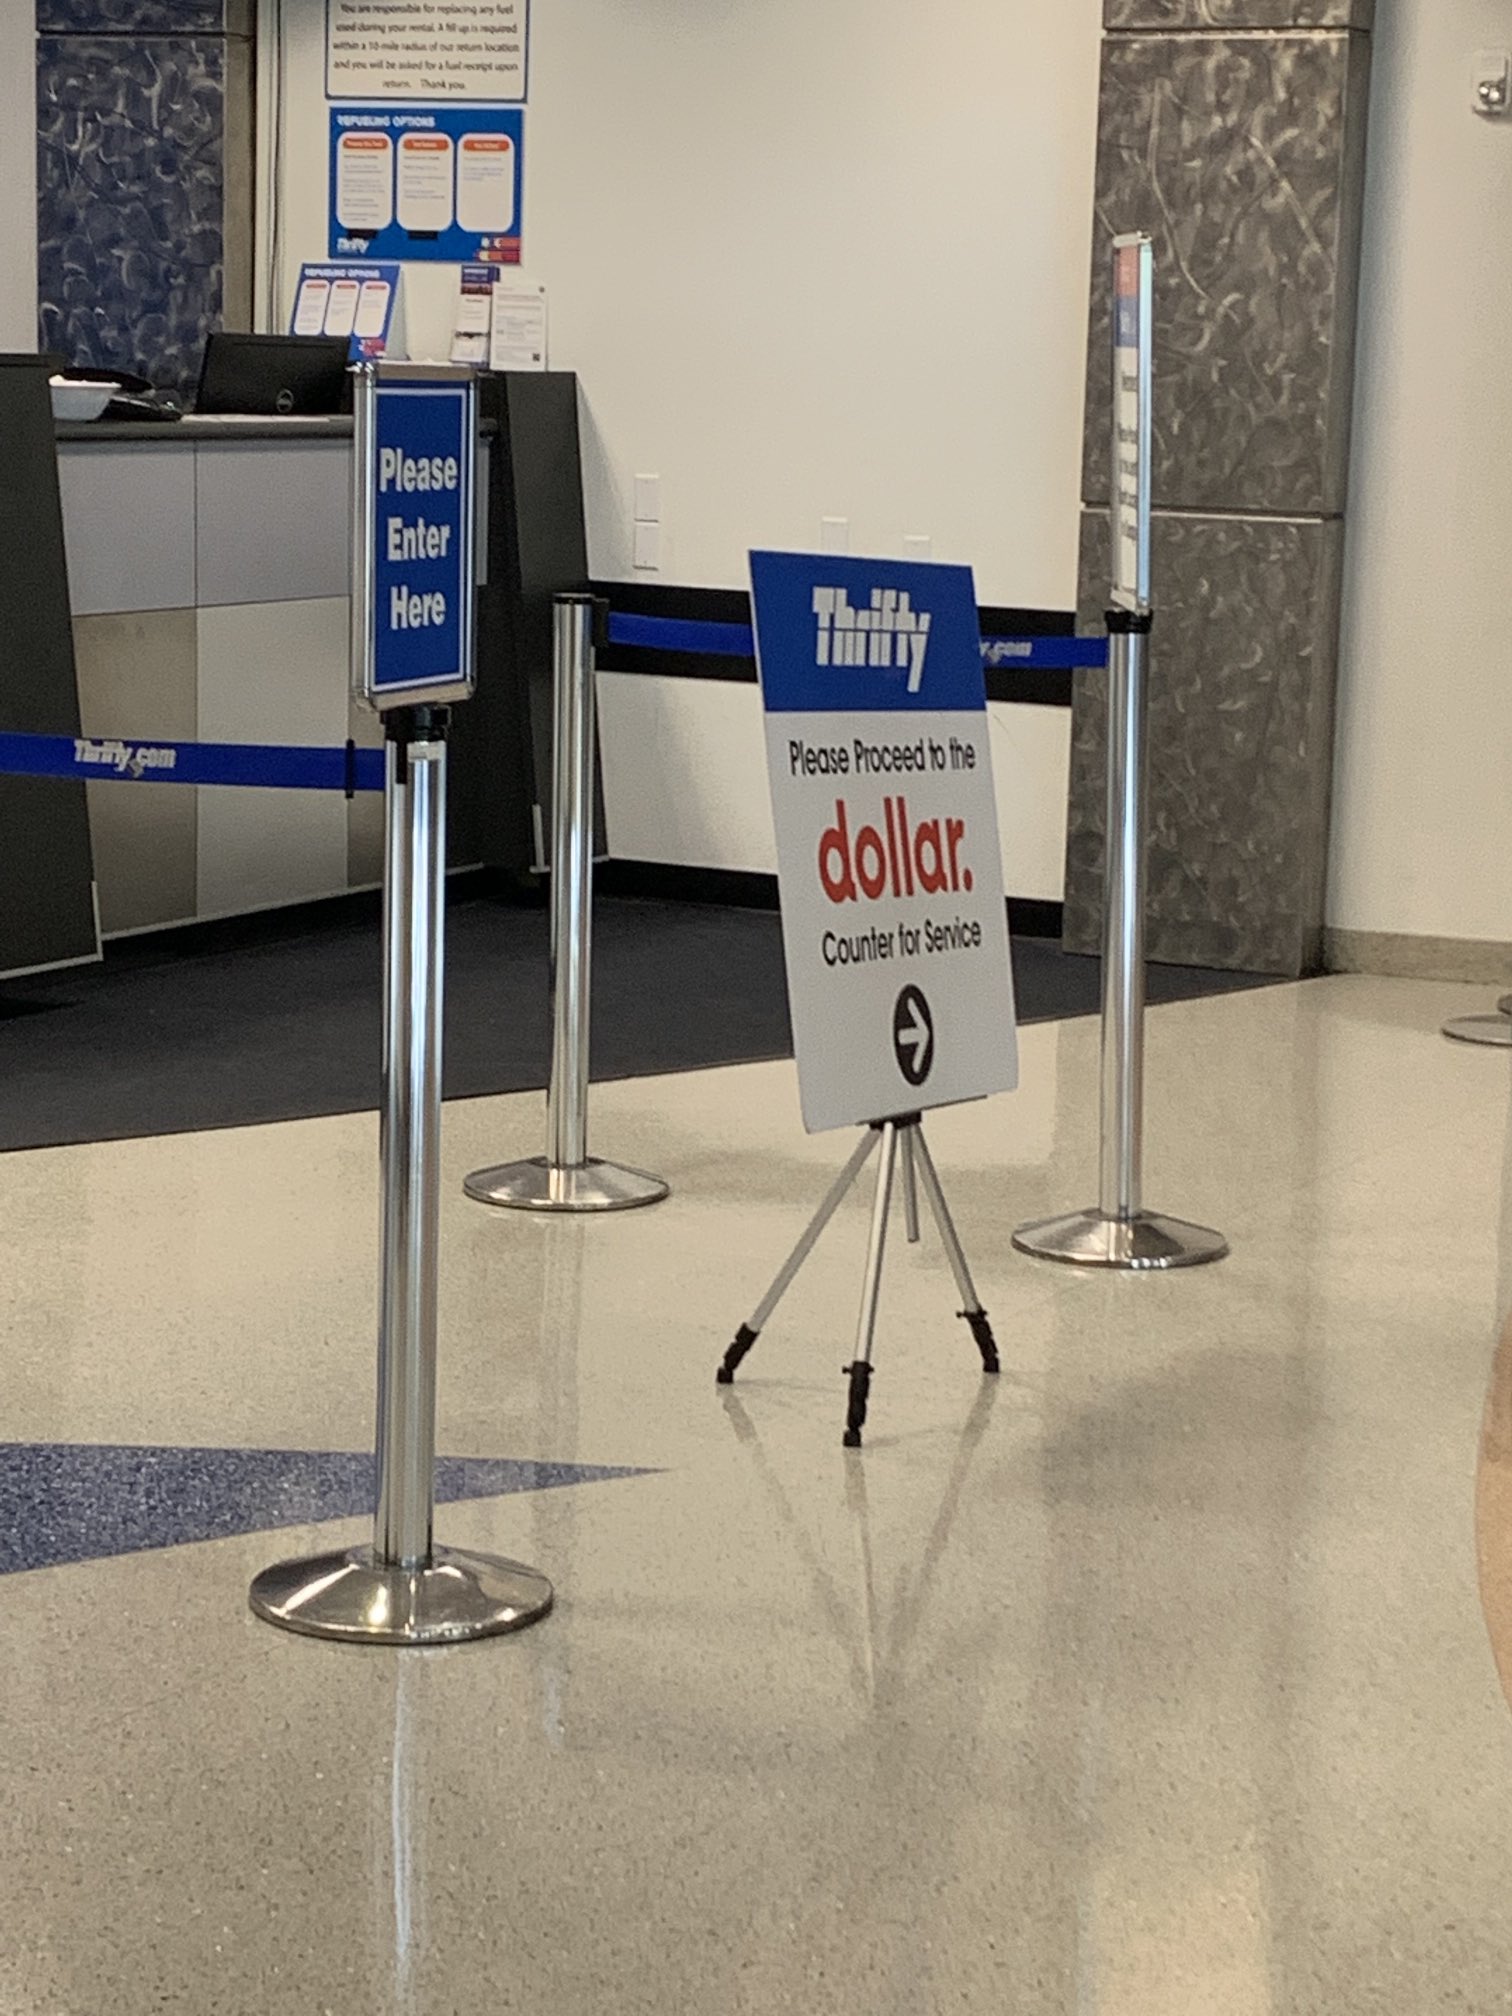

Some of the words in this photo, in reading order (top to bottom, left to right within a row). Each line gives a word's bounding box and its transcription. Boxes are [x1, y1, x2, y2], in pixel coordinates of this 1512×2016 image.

[379, 447, 459, 492] Please
[387, 516, 450, 561] Enter
[390, 585, 447, 630] Here
[812, 586, 931, 692] Thrifty
[788, 739, 850, 776] Please
[853, 738, 926, 774] Proceed
[928, 737, 947, 771] to
[949, 736, 976, 770] the
[822, 926, 894, 967] Counter
[899, 922, 921, 957] for
[924, 916, 982, 953] Service
